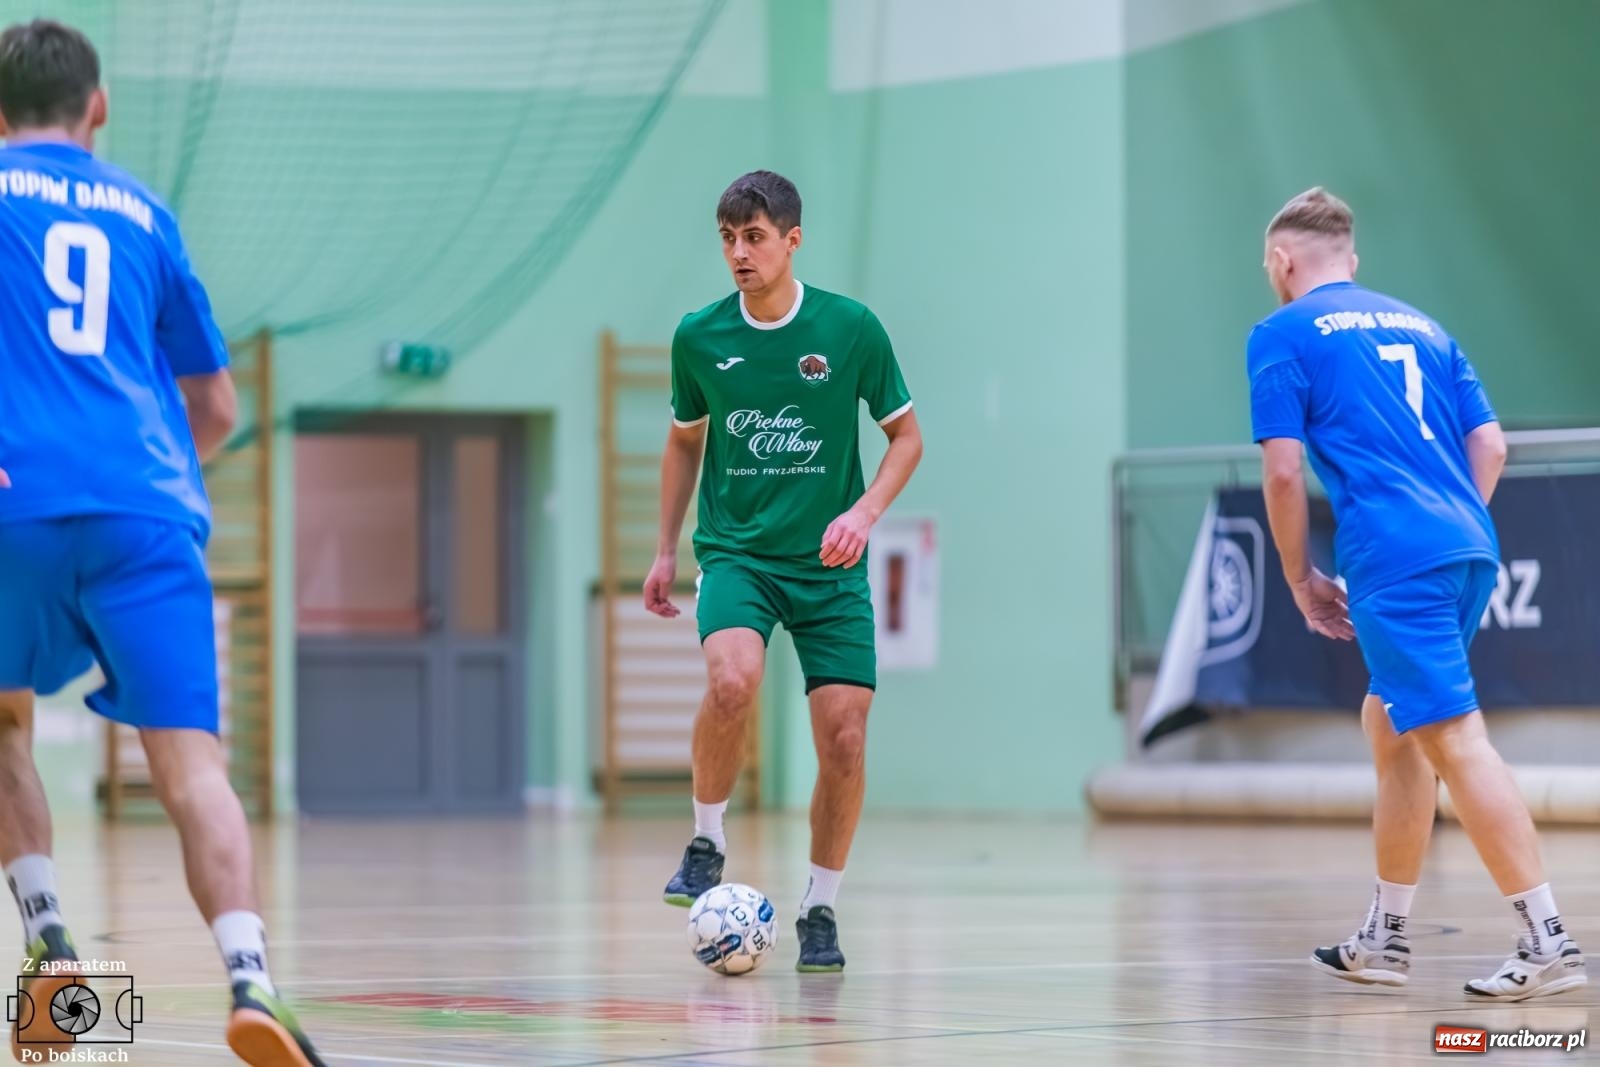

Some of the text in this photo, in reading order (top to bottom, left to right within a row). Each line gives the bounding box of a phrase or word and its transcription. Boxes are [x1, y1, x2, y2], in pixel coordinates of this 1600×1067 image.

[44, 221, 110, 356] 9
[1376, 343, 1435, 440] 7
[726, 404, 803, 438] Piękne
[748, 426, 823, 465] Włosy
[763, 466, 826, 475] FRYZJERSKIE
